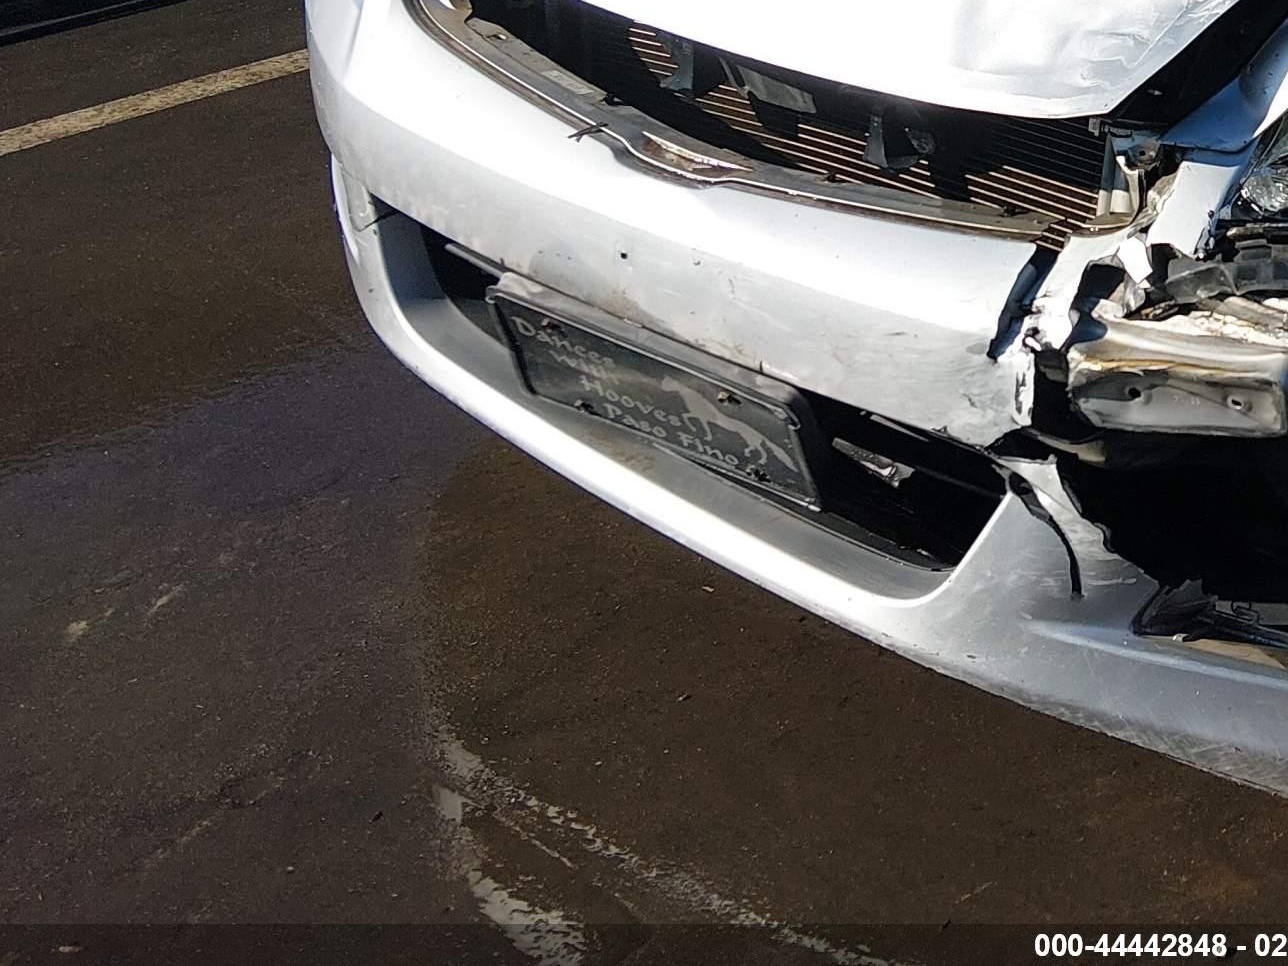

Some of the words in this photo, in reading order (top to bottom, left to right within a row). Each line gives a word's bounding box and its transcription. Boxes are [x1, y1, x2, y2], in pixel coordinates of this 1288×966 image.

[510, 316, 616, 367] Dances
[579, 374, 683, 427] Hooves
[602, 402, 668, 438] Paso
